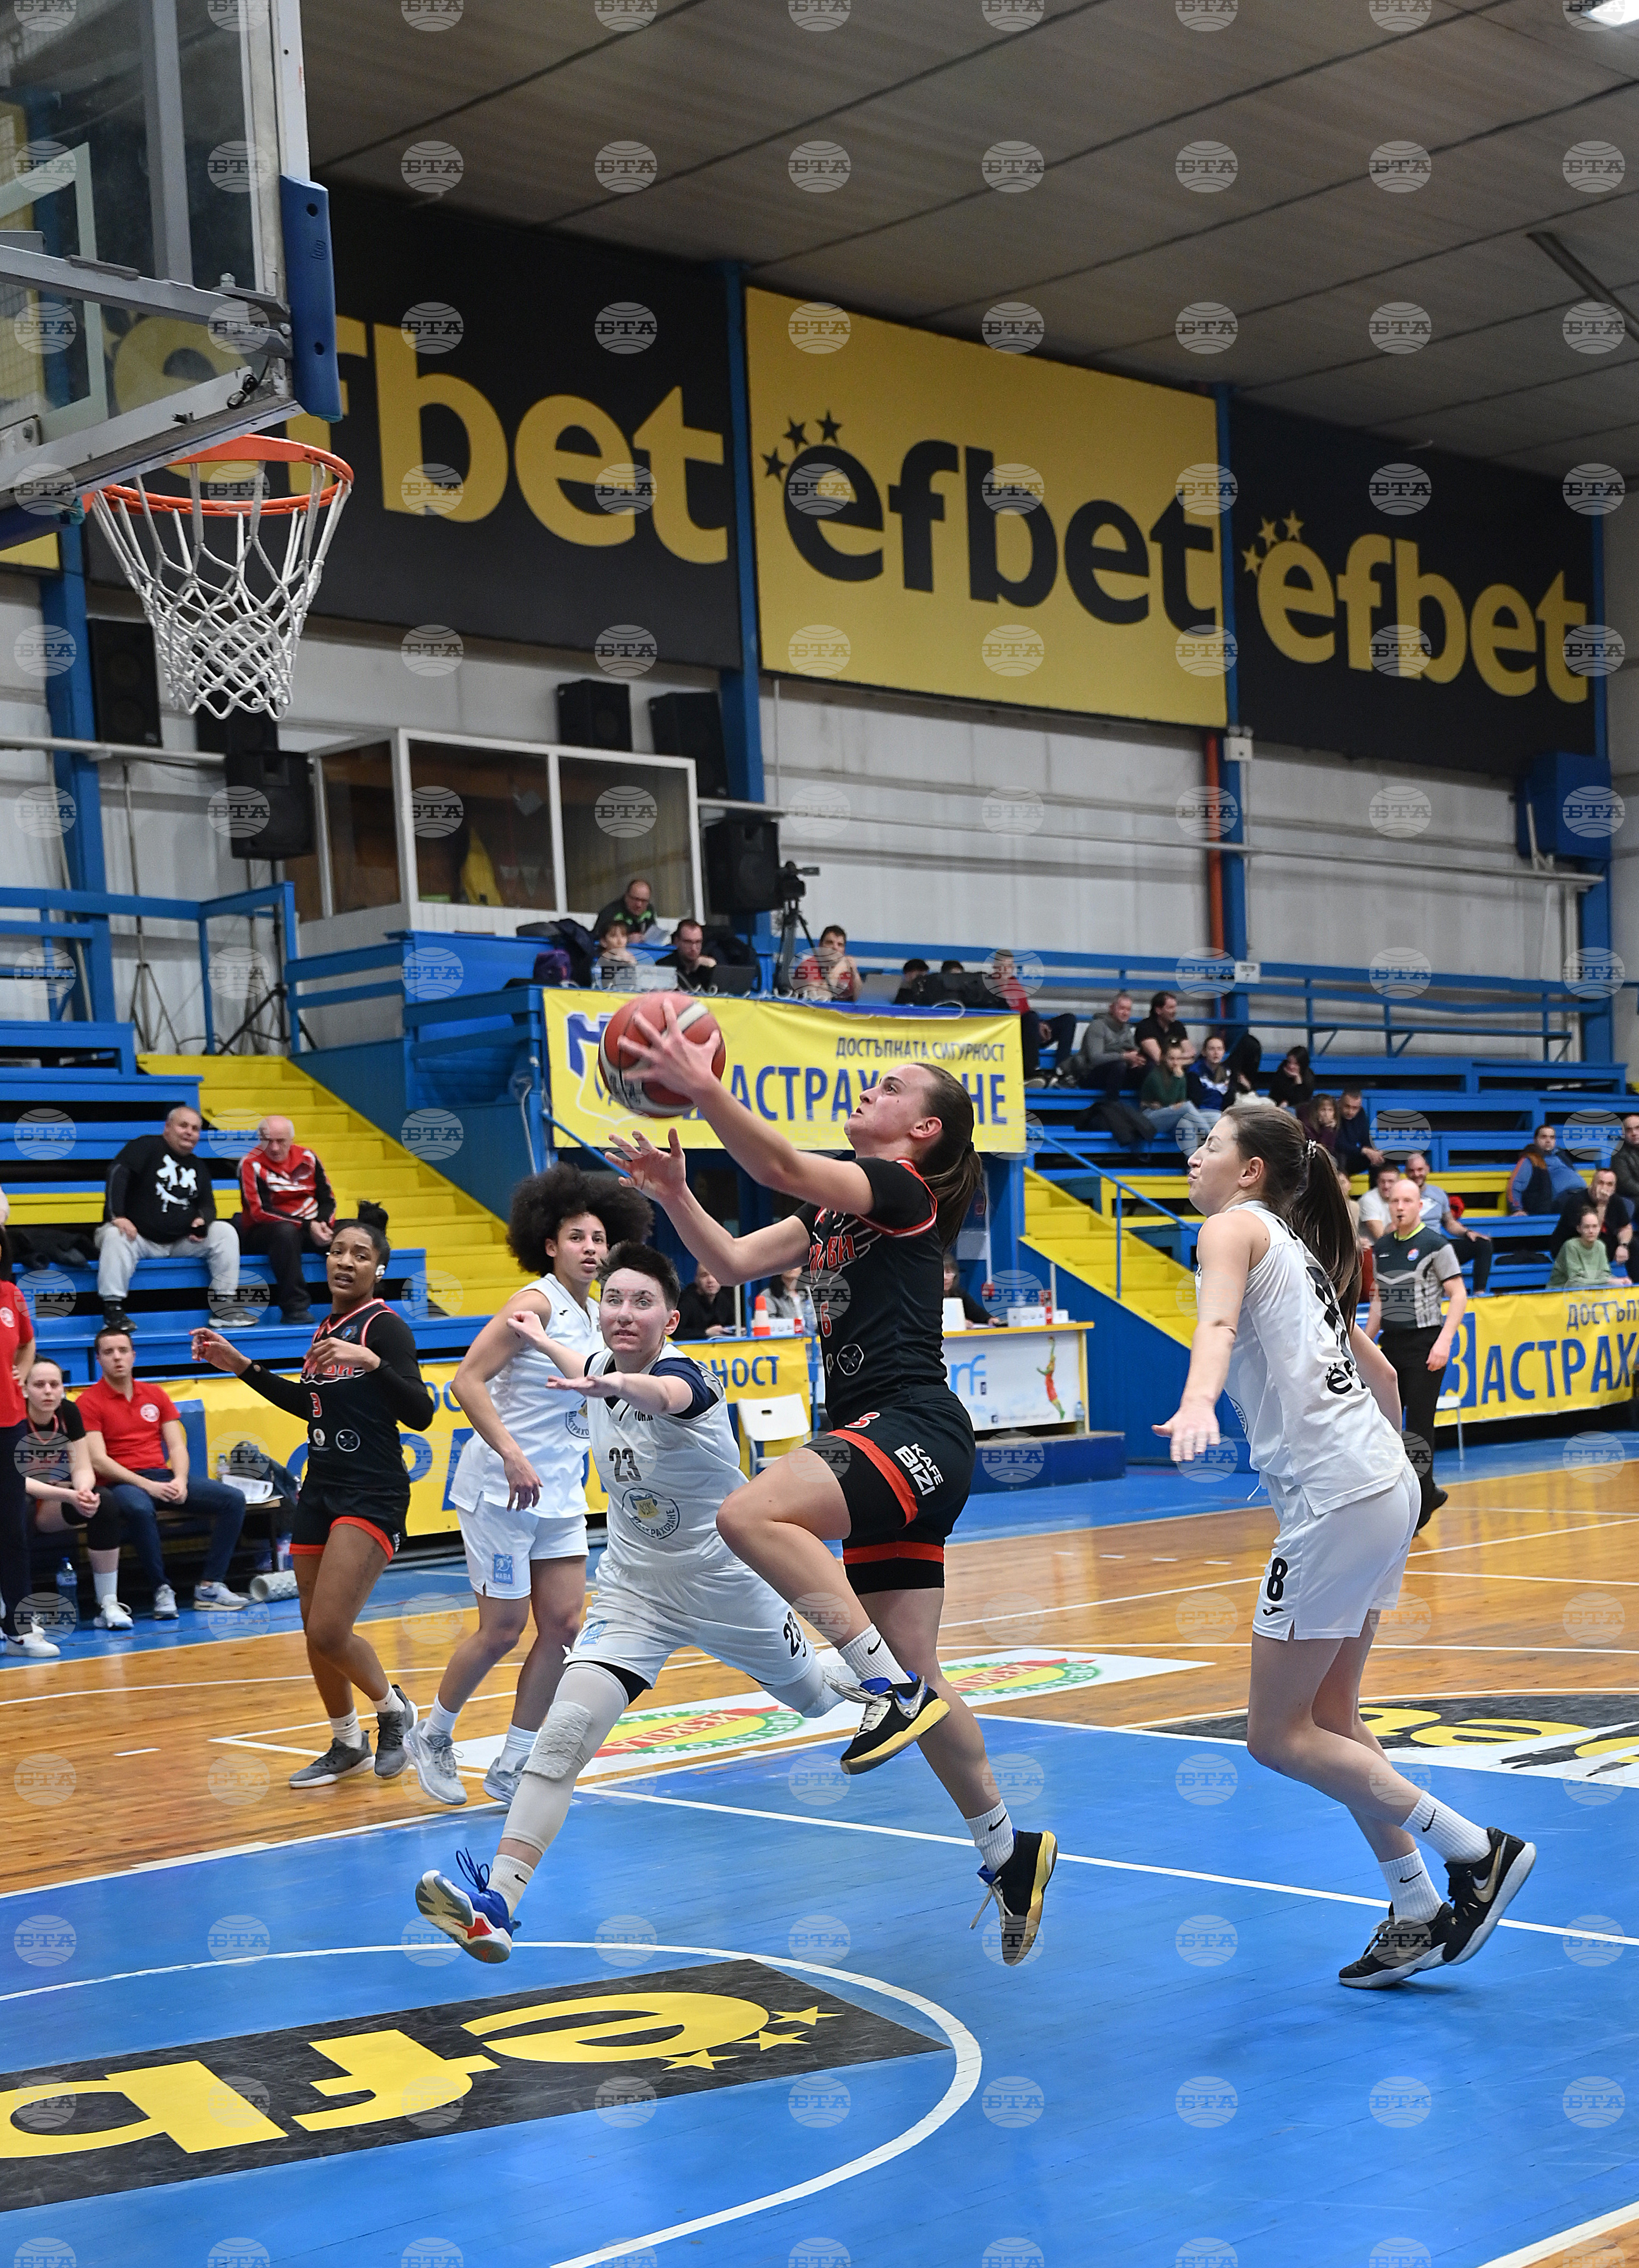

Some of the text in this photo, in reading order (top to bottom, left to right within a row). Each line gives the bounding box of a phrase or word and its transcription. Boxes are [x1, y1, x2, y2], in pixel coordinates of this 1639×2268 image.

[783, 439, 1216, 636] efbet
[1257, 534, 1588, 704] efbet
[836, 1036, 930, 1059] ДОСТЪПНАТА
[1567, 1300, 1639, 1332] ДОСТЪП
[609, 1447, 642, 1483] 23
[894, 1445, 936, 1496] BIZI
[910, 1443, 944, 1486] KAFE
[1266, 1557, 1288, 1601] 8
